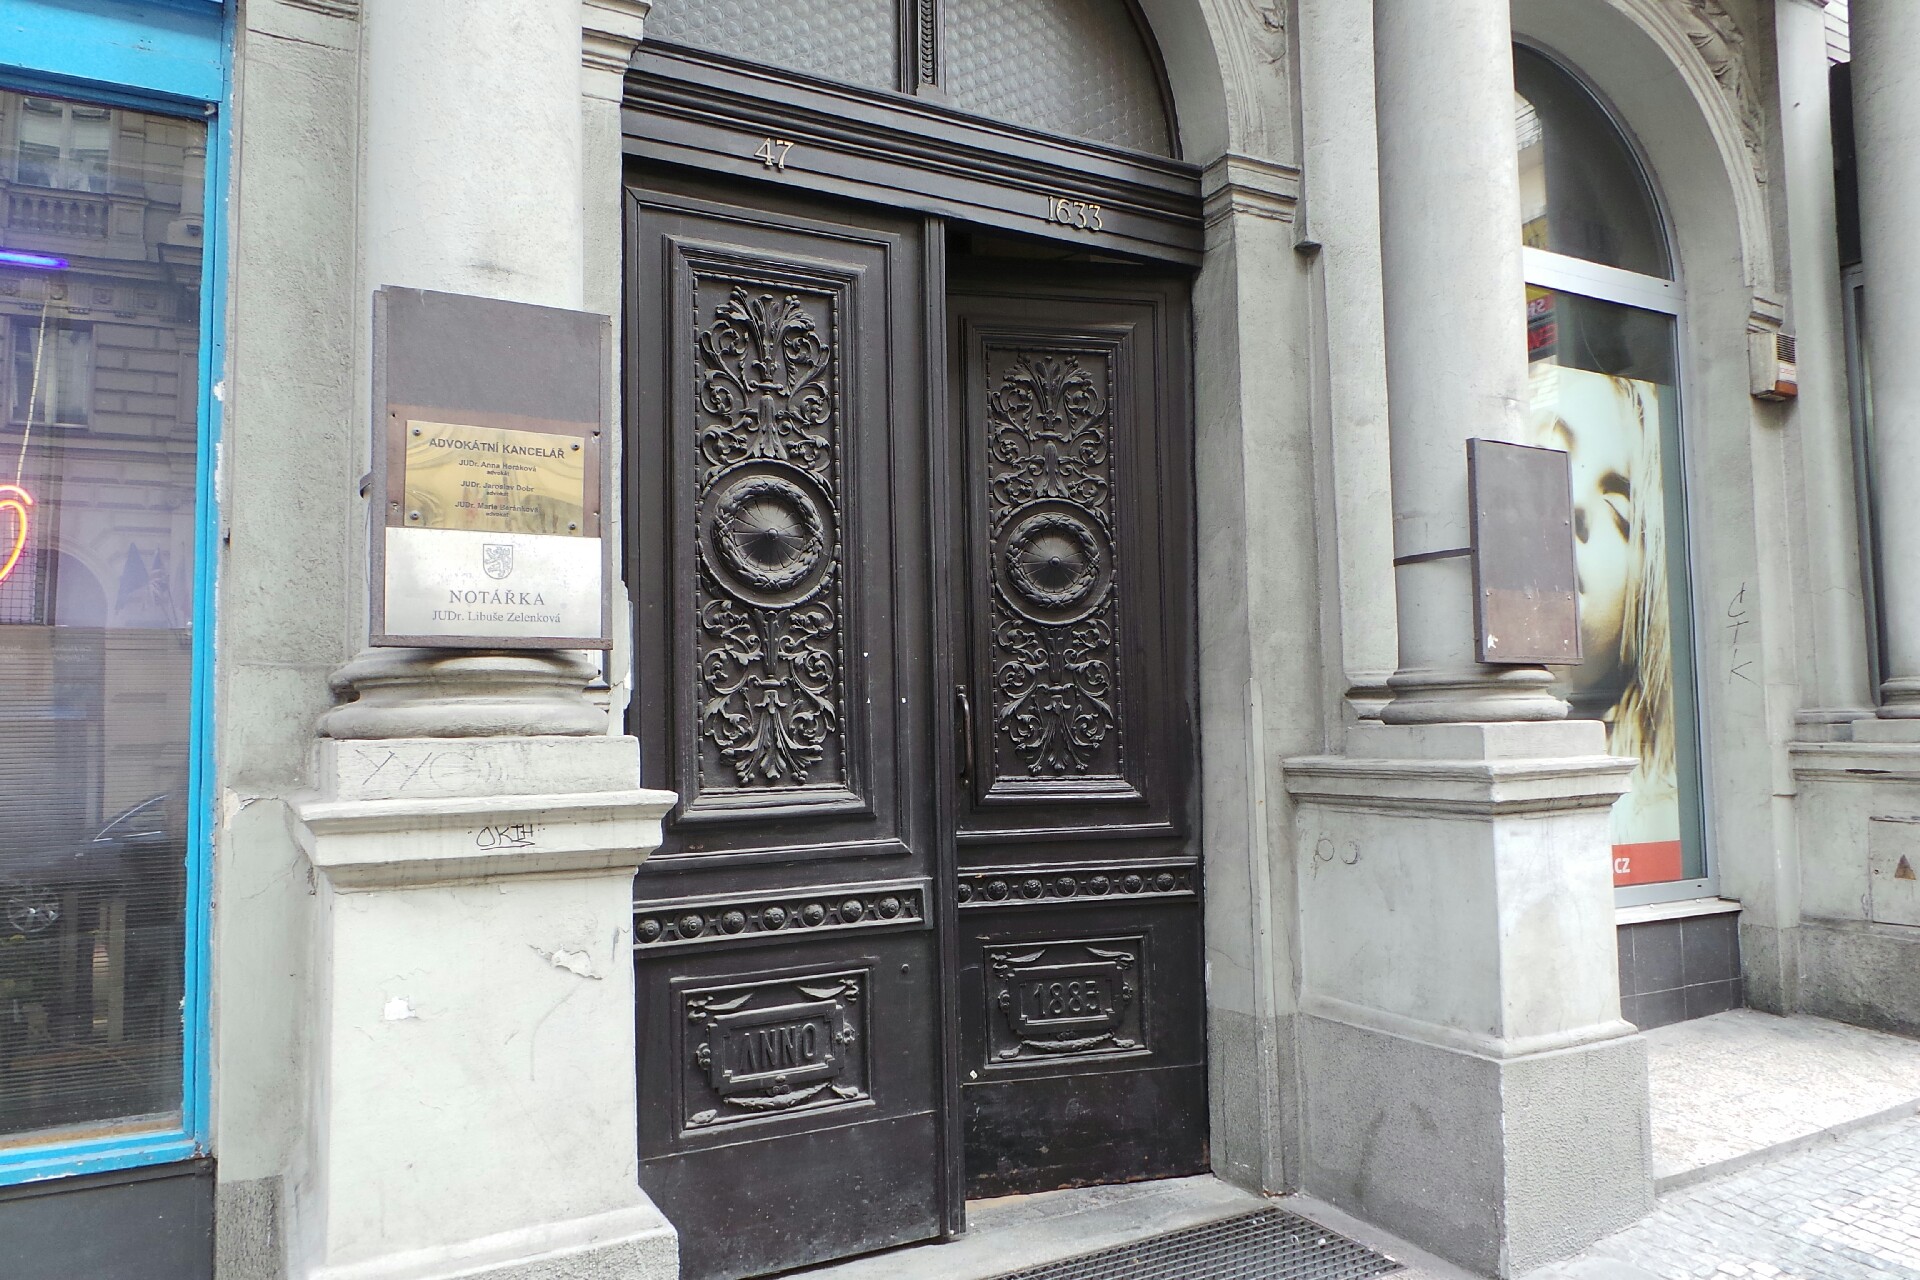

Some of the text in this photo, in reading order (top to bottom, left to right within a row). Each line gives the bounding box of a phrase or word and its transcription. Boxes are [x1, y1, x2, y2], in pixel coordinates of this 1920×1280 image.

[754, 137, 794, 169] 47
[1048, 195, 1102, 230] 1633
[428, 437, 565, 459] ADVOKÁTNÍ KANCELÁŘ
[458, 459, 479, 468] JUDr.
[480, 461, 501, 469] Anna
[460, 480, 481, 489] JUDr.
[482, 482, 515, 491] Jaroslav
[455, 501, 476, 509] JUDr.
[449, 589, 545, 606] NOTÁŘKA
[432, 610, 561, 623] JUDr. Libuše Zelenková
[1033, 980, 1101, 1016] 1885
[740, 1022, 817, 1072] ANNO
